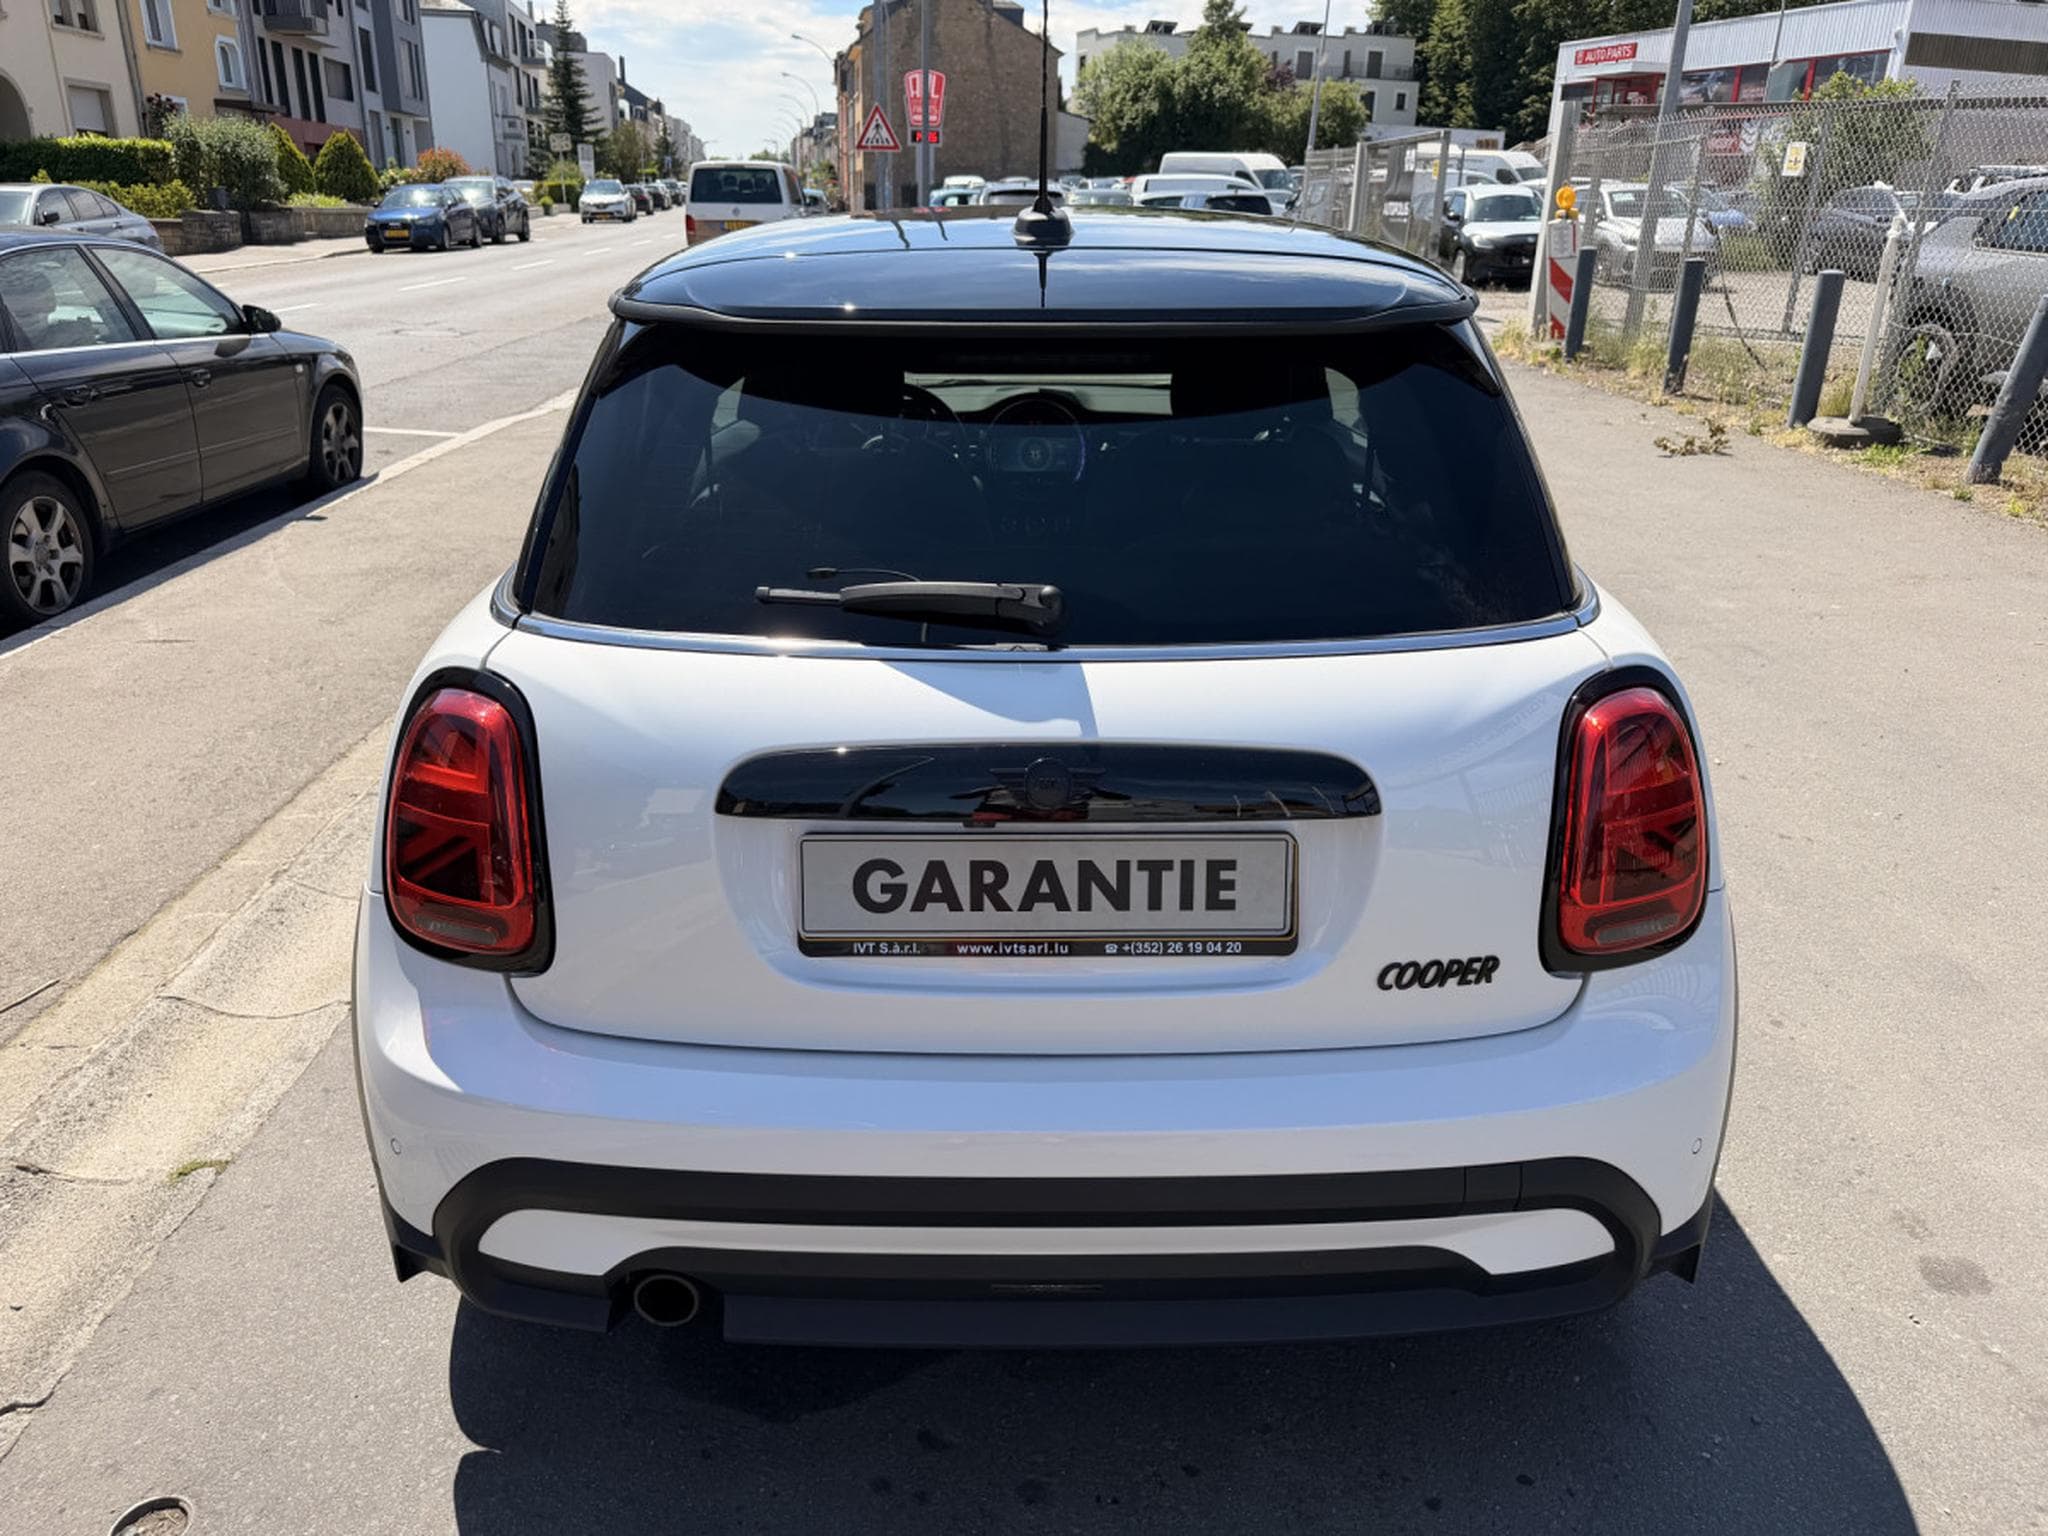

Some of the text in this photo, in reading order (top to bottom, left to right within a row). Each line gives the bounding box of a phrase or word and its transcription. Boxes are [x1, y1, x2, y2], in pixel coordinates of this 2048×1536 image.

[1585, 45, 1633, 62] AUTO PARTS
[852, 858, 1238, 914] GARANTIE
[853, 942, 875, 954] IVT
[957, 942, 1069, 954] www.ivtsarl.lu
[1122, 942, 1164, 956] +(352)
[1167, 942, 1184, 954] 26
[1187, 942, 1202, 954] 19
[1206, 942, 1222, 954] 04
[1226, 942, 1242, 954] 20
[1376, 955, 1500, 991] COOPER
